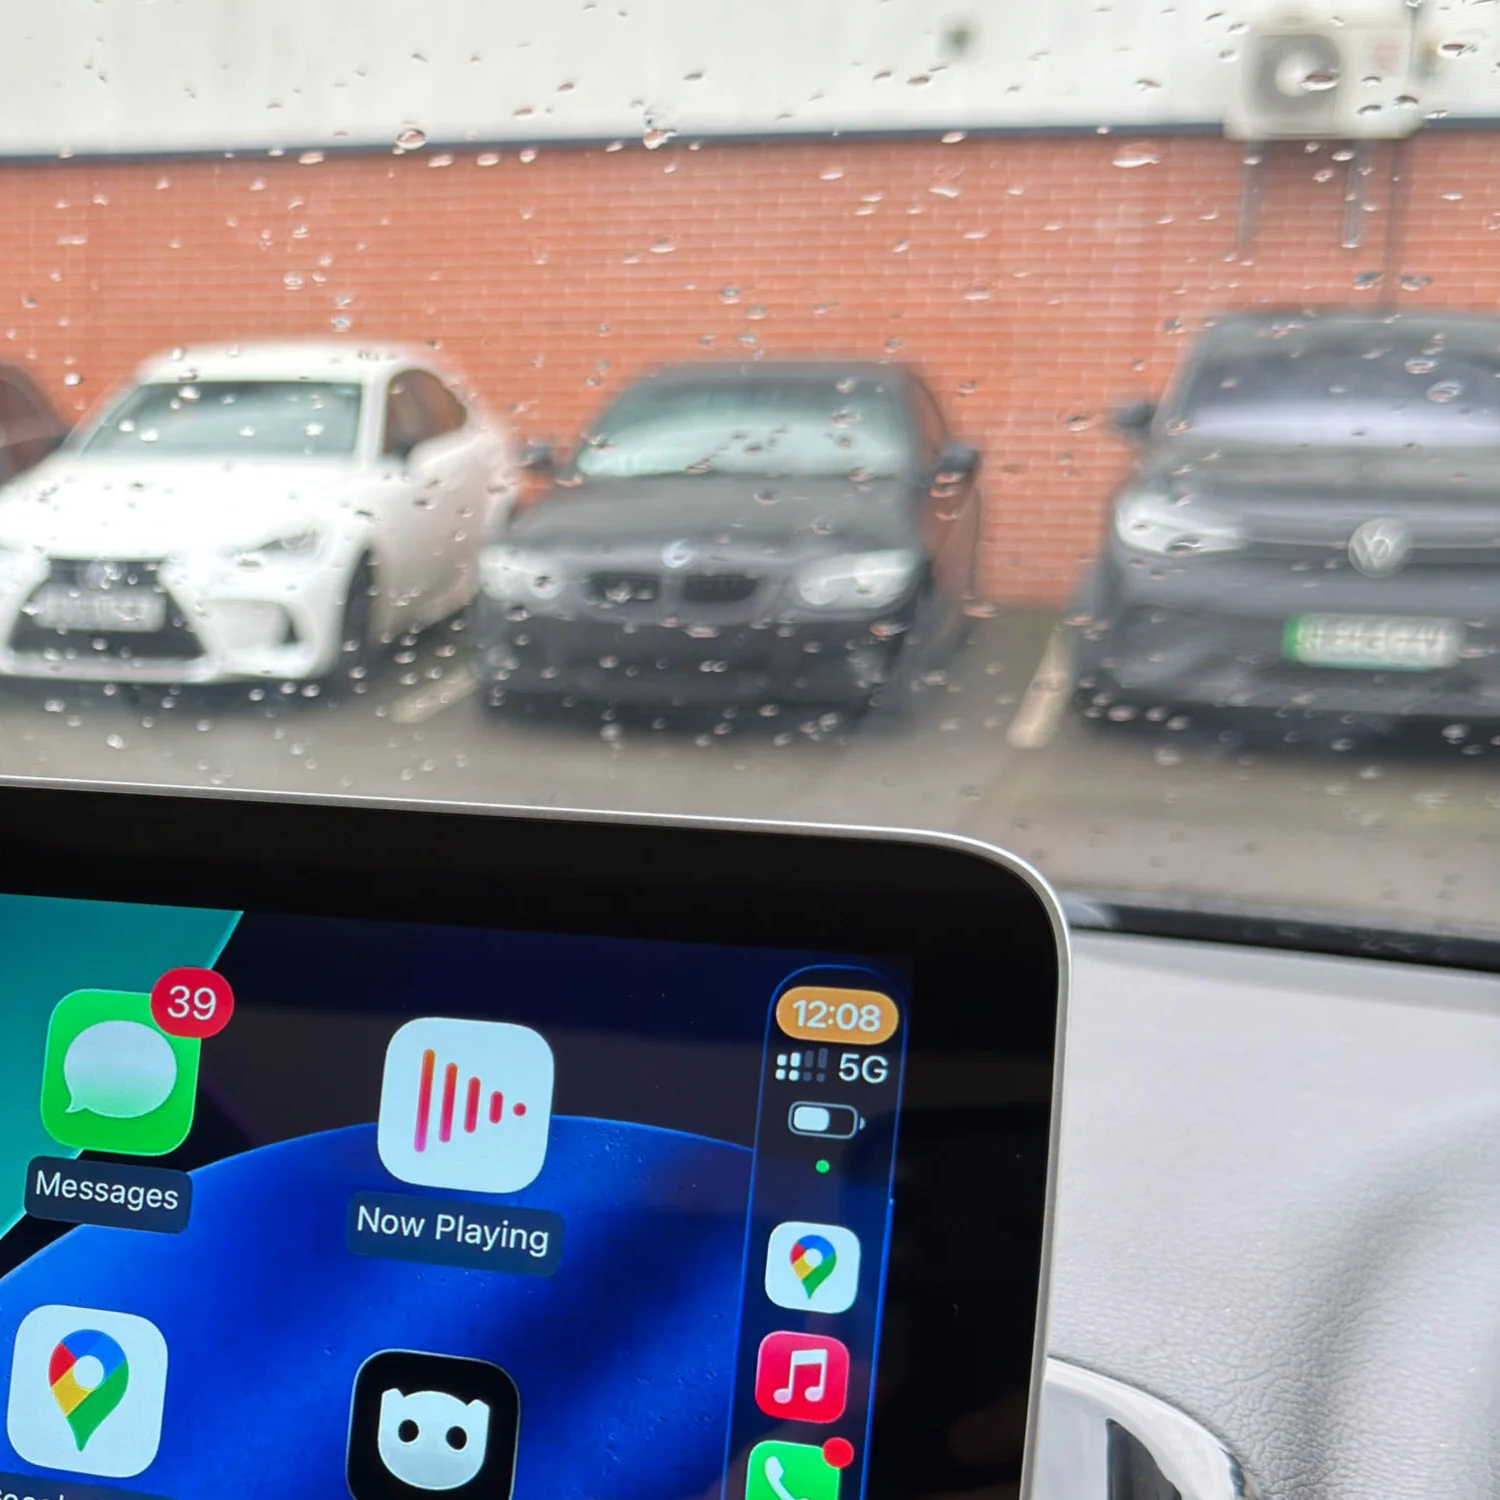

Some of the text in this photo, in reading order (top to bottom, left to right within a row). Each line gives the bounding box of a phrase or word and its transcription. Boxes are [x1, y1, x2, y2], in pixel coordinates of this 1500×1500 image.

[166, 984, 217, 1021] 39
[791, 998, 882, 1033] 12:08
[838, 1053, 889, 1084] 5G
[35, 1169, 180, 1212] Messages
[356, 1203, 550, 1257] Now Playing
